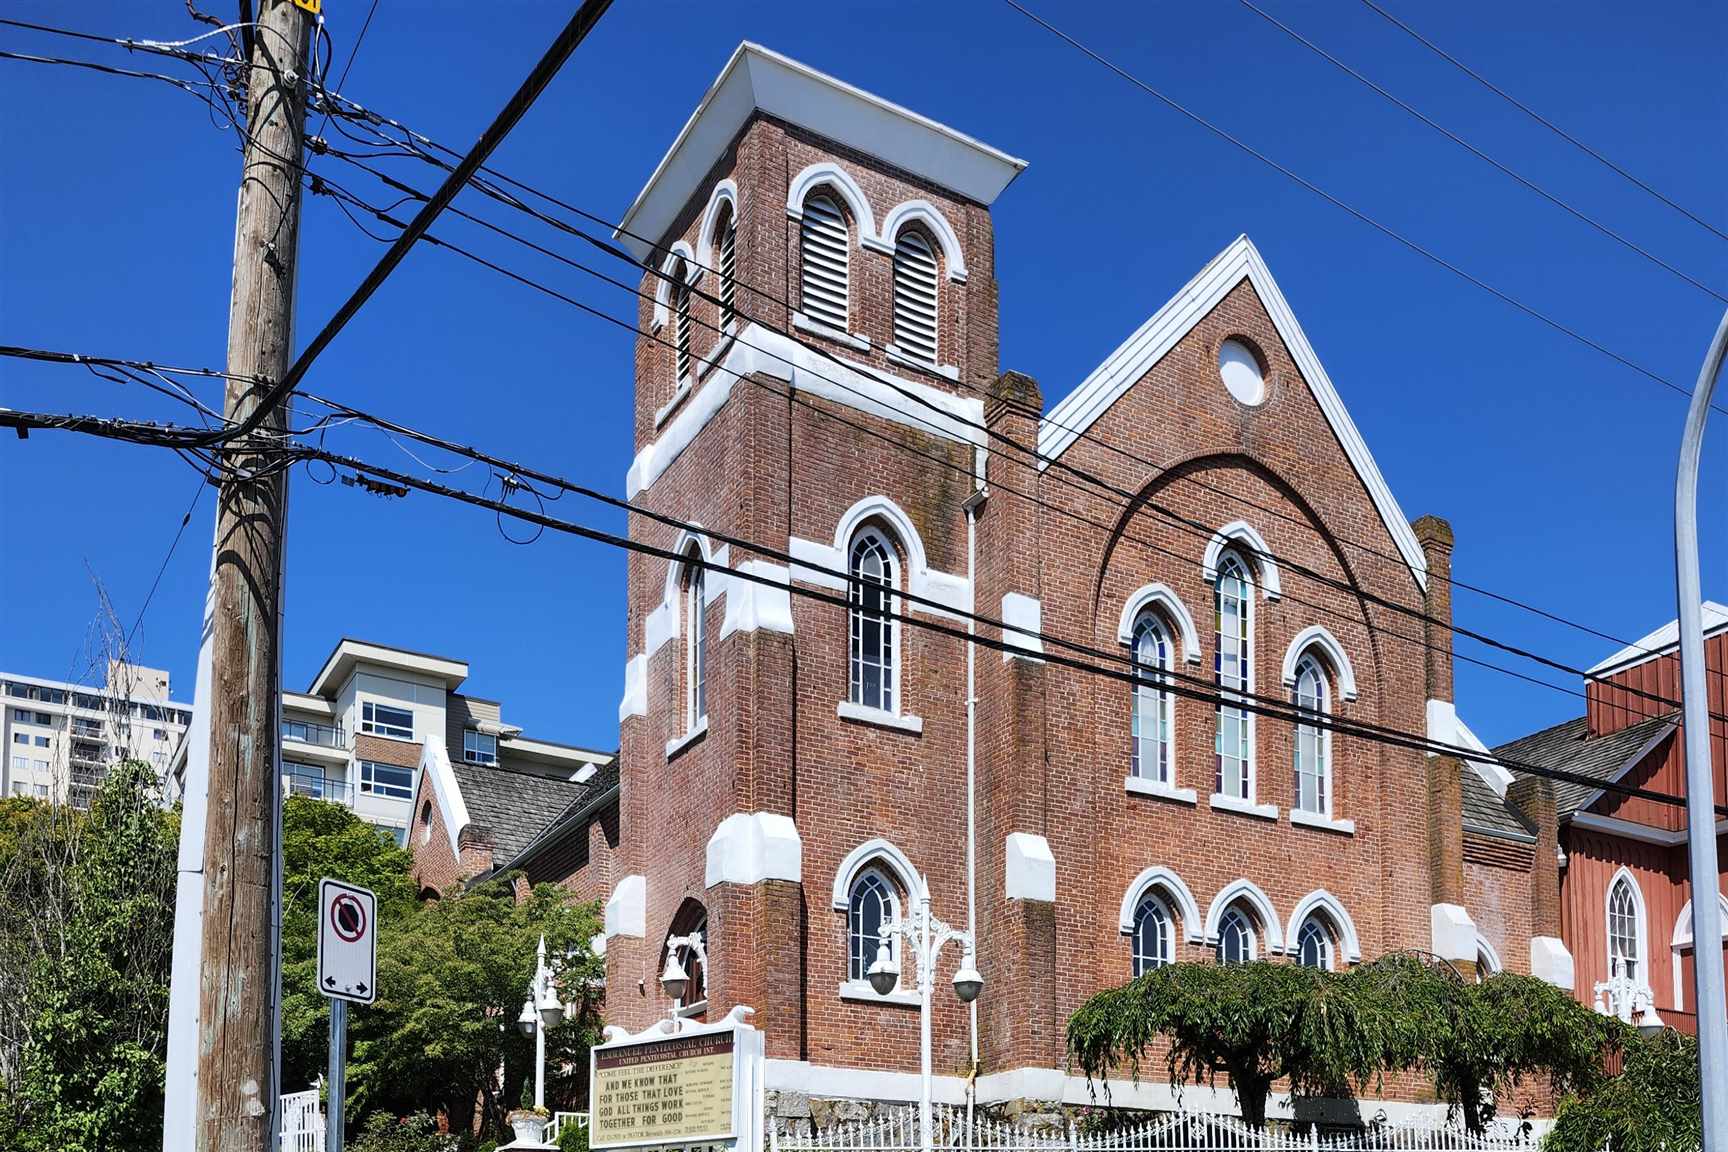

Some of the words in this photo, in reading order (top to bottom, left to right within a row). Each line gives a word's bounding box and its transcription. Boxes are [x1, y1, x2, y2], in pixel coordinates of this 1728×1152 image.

[605, 1081, 620, 1092] AND
[622, 1079, 632, 1089] WE
[634, 1076, 655, 1087] KNOW
[658, 1074, 678, 1084] THAT
[599, 1093, 613, 1105] FOR
[616, 1090, 639, 1102] THOSE
[643, 1088, 661, 1100] THAT
[663, 1086, 684, 1098] LOVE
[599, 1106, 613, 1117] GOD
[617, 1104, 631, 1115] ALL
[632, 1101, 659, 1113] THINGS
[661, 1099, 684, 1111] WORK
[599, 1117, 636, 1129] TOGETHER
[642, 1115, 657, 1126] FOR
[662, 1112, 683, 1122] GOOD
